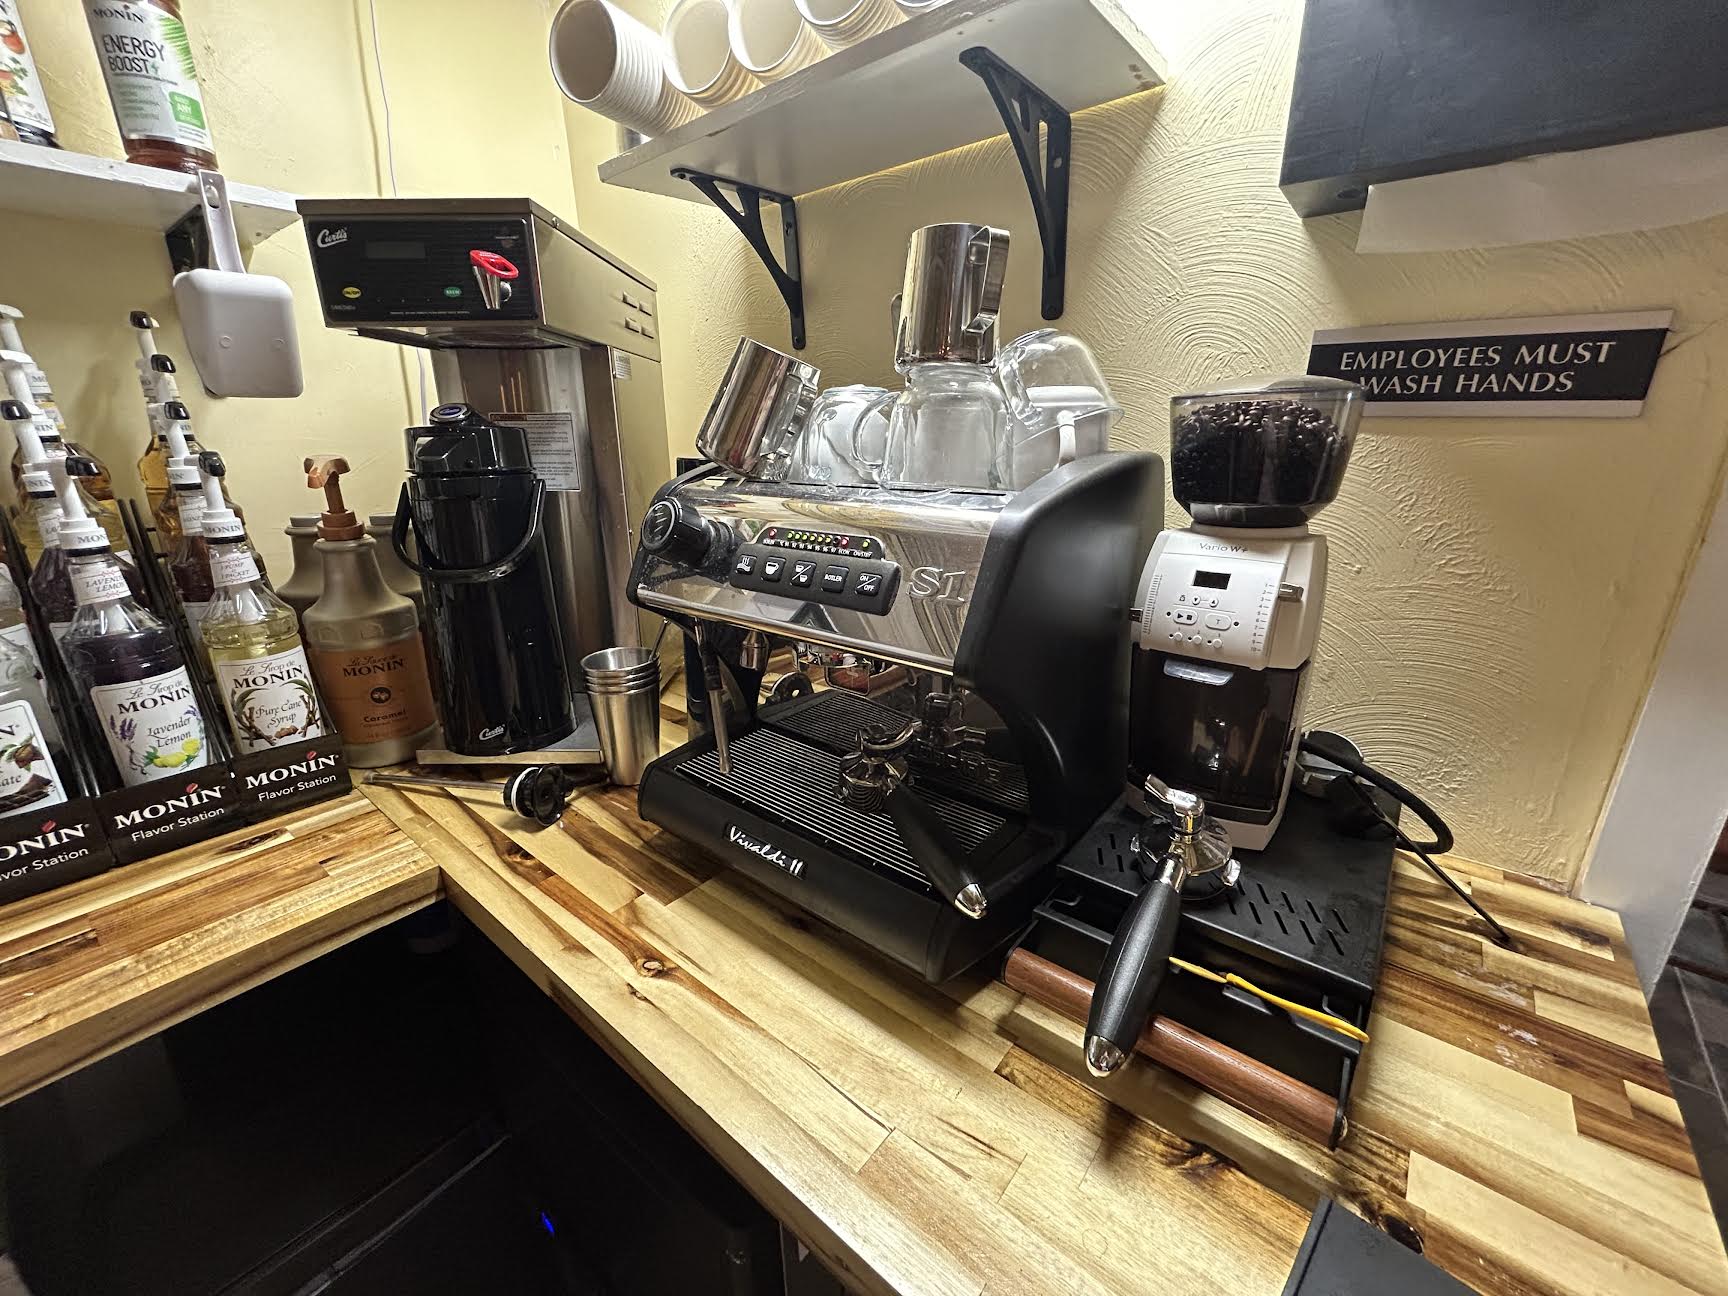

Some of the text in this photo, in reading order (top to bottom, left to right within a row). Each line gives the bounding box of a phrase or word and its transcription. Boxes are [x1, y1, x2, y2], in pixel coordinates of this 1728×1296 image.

[93, 8, 144, 23] MONIN
[102, 33, 165, 61] ENERGY
[108, 55, 149, 74] BOOST
[317, 228, 348, 248] Curtis
[1340, 341, 1616, 371] EMPLOYEES MUST
[1360, 371, 1574, 395] WASH HANDS
[204, 525, 241, 535] MONIN
[1199, 542, 1249, 554] Vario W+
[824, 573, 843, 582] BOILER
[863, 584, 875, 592] OFF
[232, 665, 303, 689] MONIN
[240, 665, 255, 677] Le
[258, 662, 286, 674] Sirop
[343, 659, 404, 677] MONIN
[117, 687, 191, 714] MONIN
[126, 687, 144, 700] Le
[147, 683, 174, 696] Sirop
[255, 704, 280, 719] Pure
[267, 712, 297, 728] Syrup
[363, 708, 406, 723] Caramel
[147, 716, 191, 739] Lavender
[156, 731, 192, 748] Lemon
[246, 754, 336, 790] MONIN
[258, 774, 337, 802] Flavor Station
[114, 785, 222, 829] MONIN
[131, 807, 225, 842] Flavor Station
[730, 826, 786, 867] Vivaldi
[0, 847, 89, 881] vor Station
